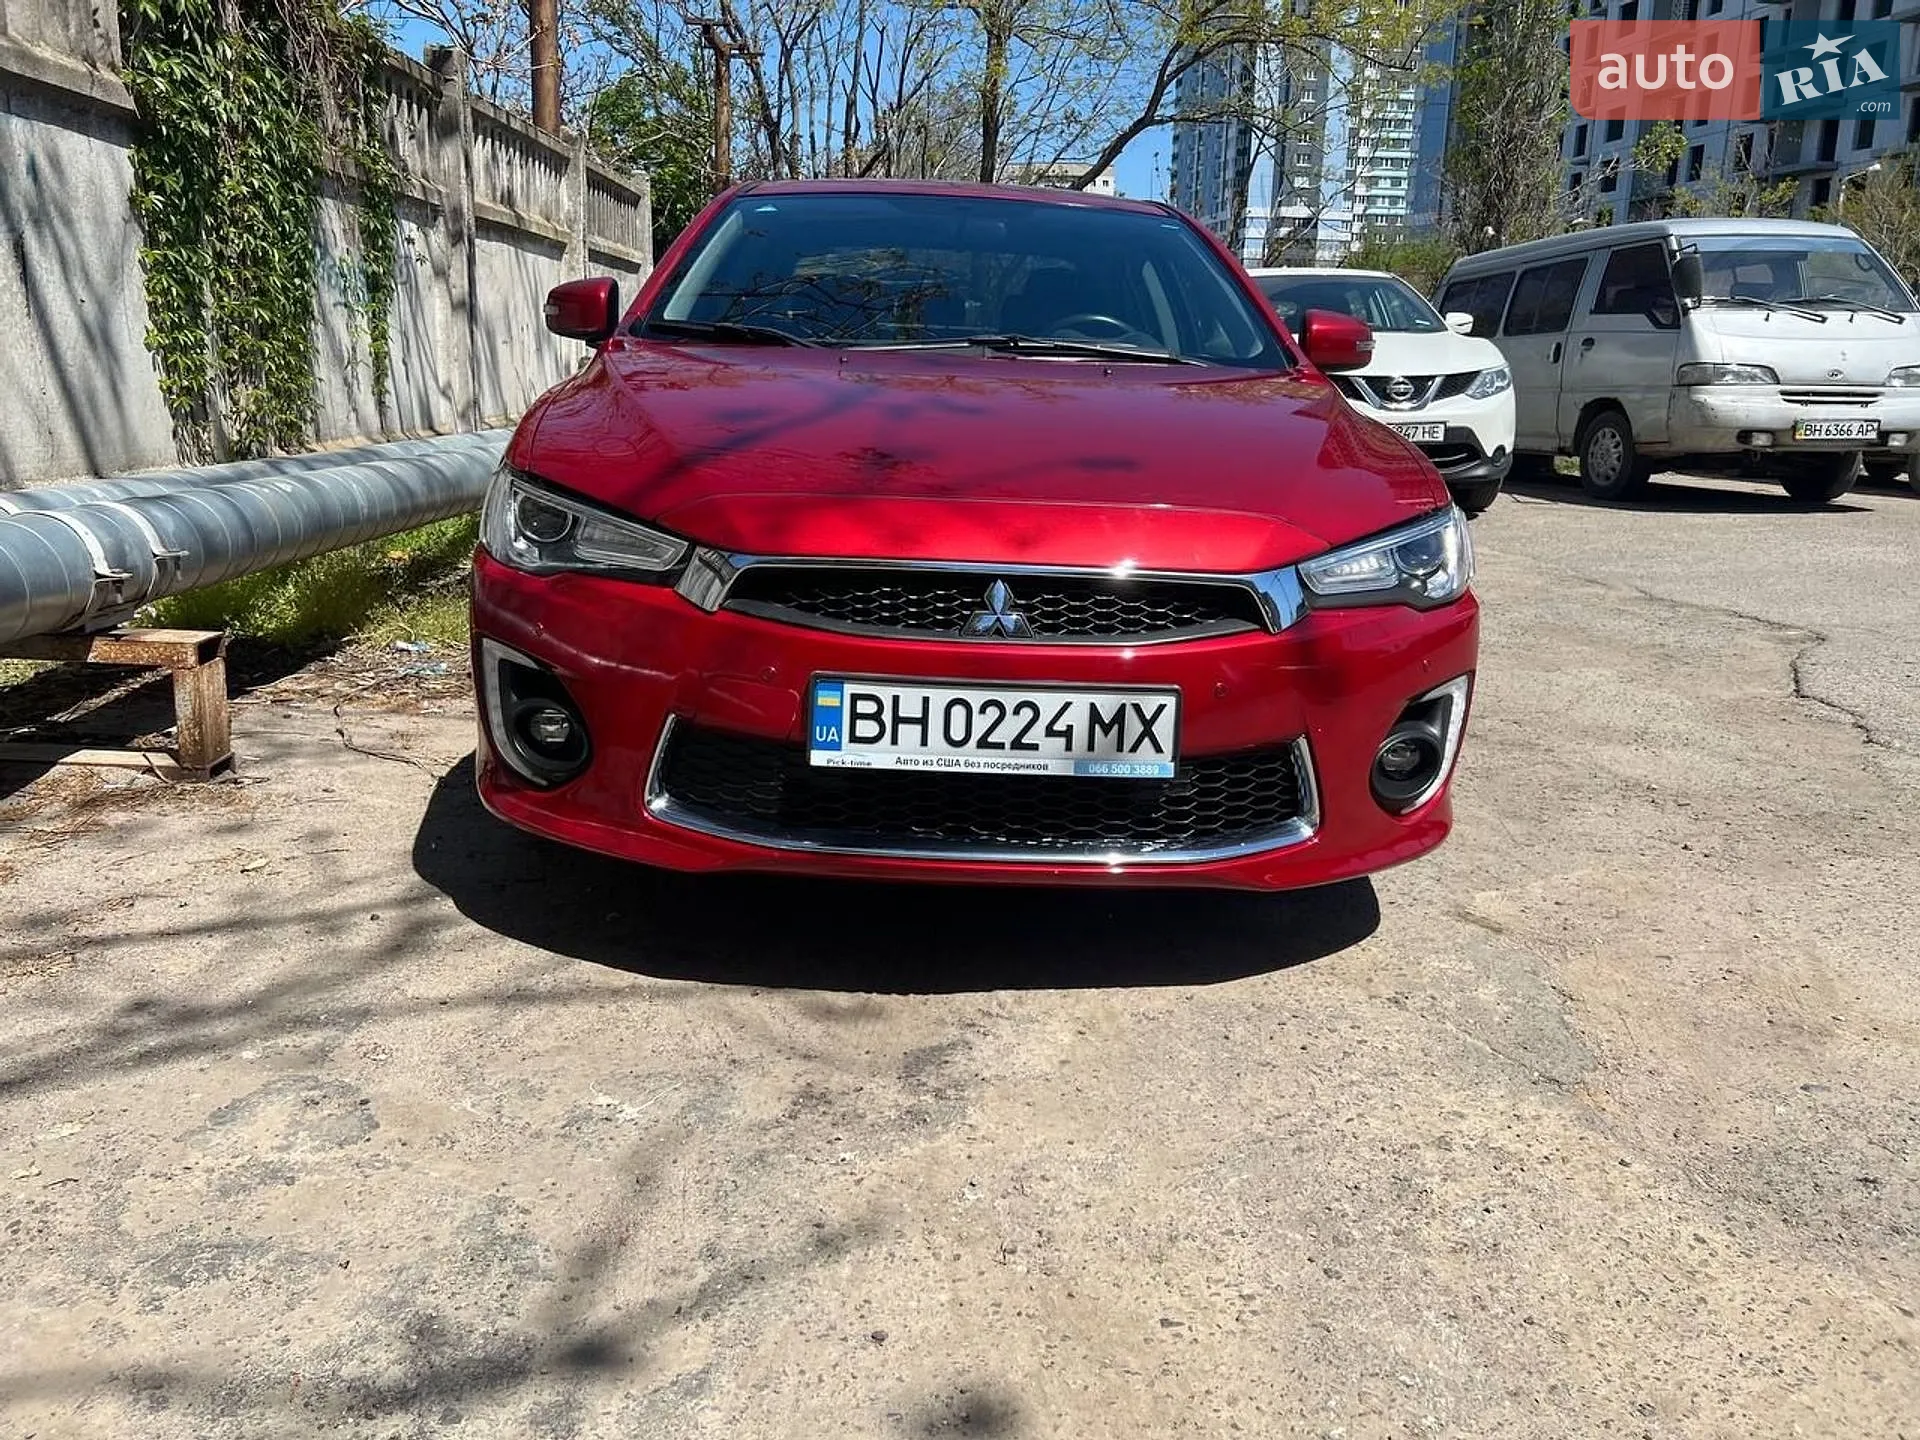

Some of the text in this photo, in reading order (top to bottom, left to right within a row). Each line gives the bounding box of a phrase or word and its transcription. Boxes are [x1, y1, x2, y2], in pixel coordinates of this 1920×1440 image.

[1422, 425, 1440, 439] HE
[1804, 424, 1875, 437] BH 6366 AP
[848, 692, 1168, 755] BH 0224 MX
[815, 725, 840, 743] UA
[895, 756, 1049, 772] Авто из США без посредников
[1111, 763, 1131, 775] 500
